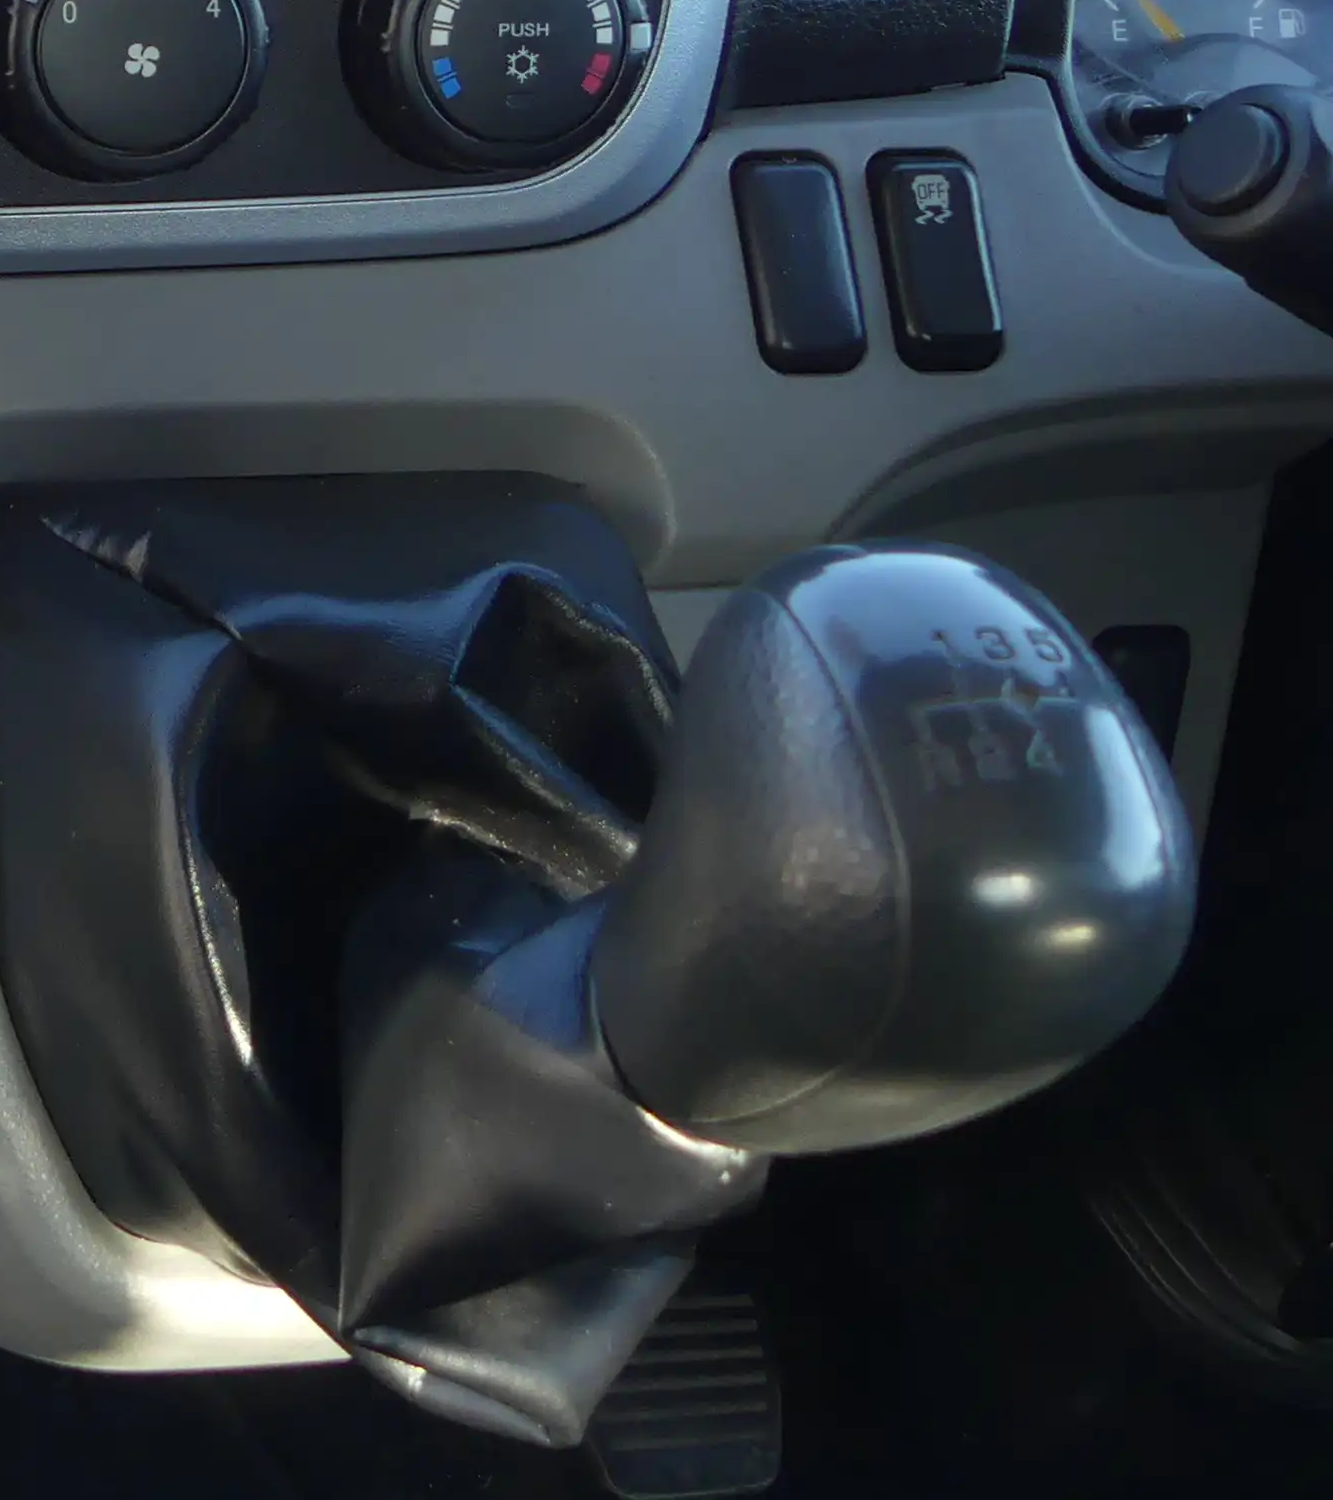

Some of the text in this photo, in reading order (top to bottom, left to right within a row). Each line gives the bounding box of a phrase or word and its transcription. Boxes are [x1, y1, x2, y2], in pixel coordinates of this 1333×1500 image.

[62, 1, 77, 24] 0
[498, 22, 550, 38] PUSH
[1112, 19, 1127, 43] E
[1249, 17, 1263, 38] F
[917, 183, 945, 200] OFF
